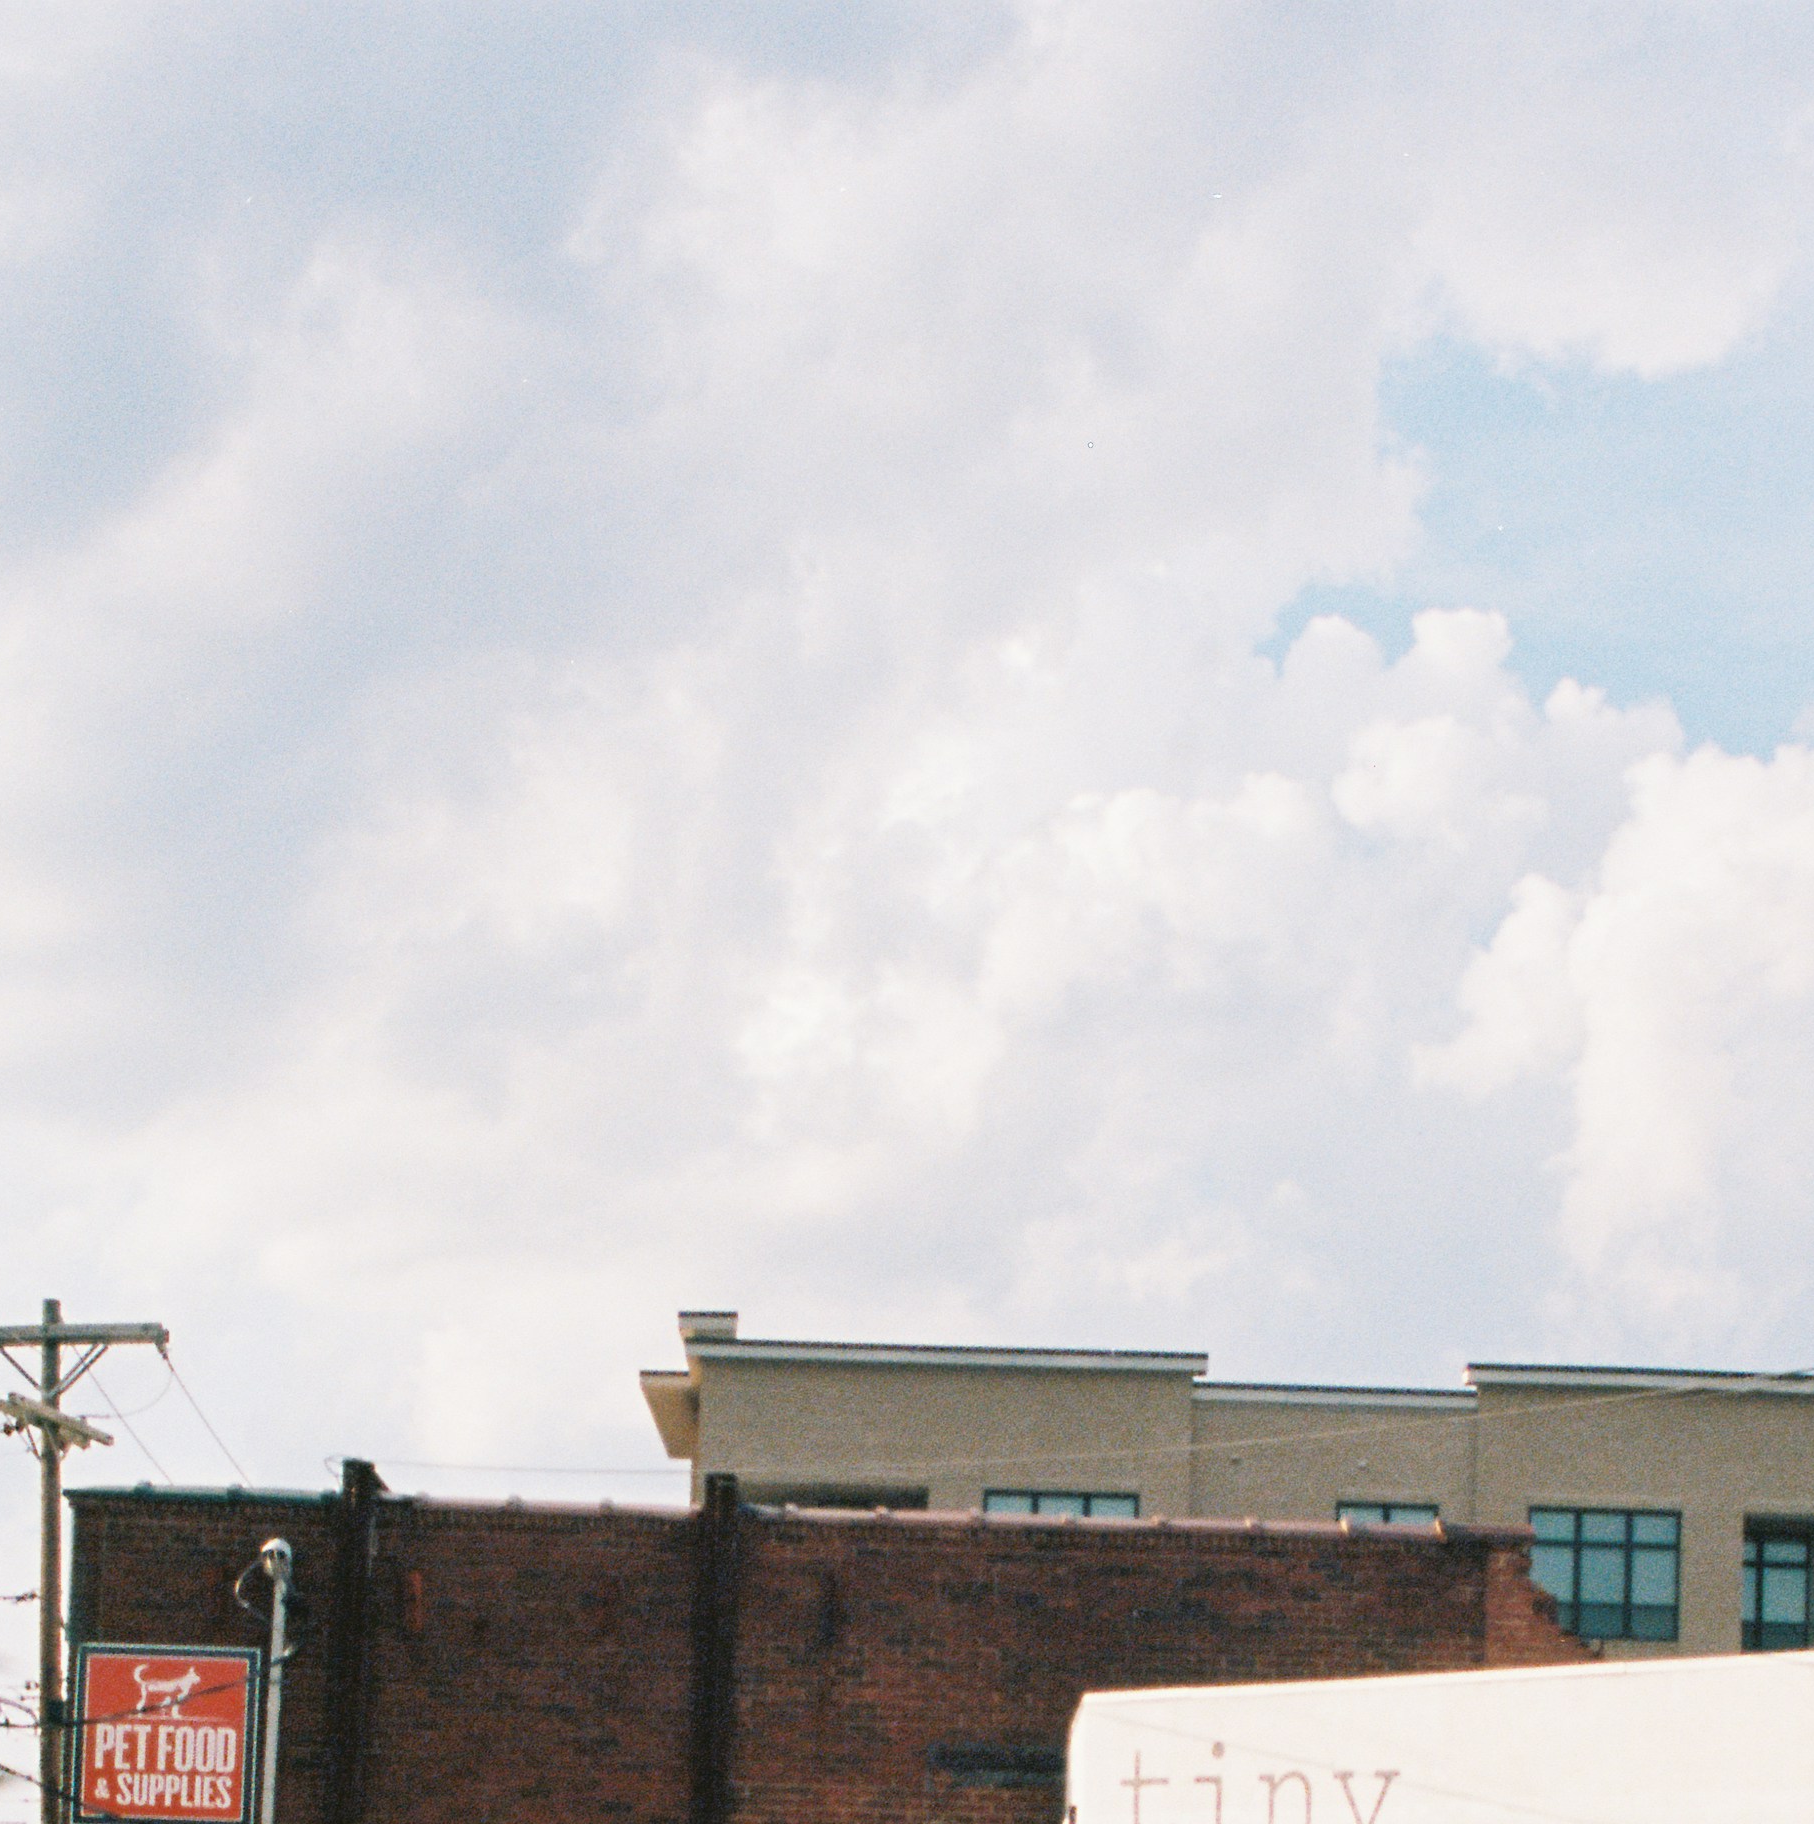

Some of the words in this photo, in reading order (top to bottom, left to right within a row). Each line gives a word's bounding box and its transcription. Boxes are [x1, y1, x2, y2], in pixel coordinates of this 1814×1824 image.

[94, 1722, 152, 1770] PET
[157, 1724, 237, 1773] FOOD
[94, 1777, 110, 1799] &
[116, 1772, 233, 1809] SUPPLIES
